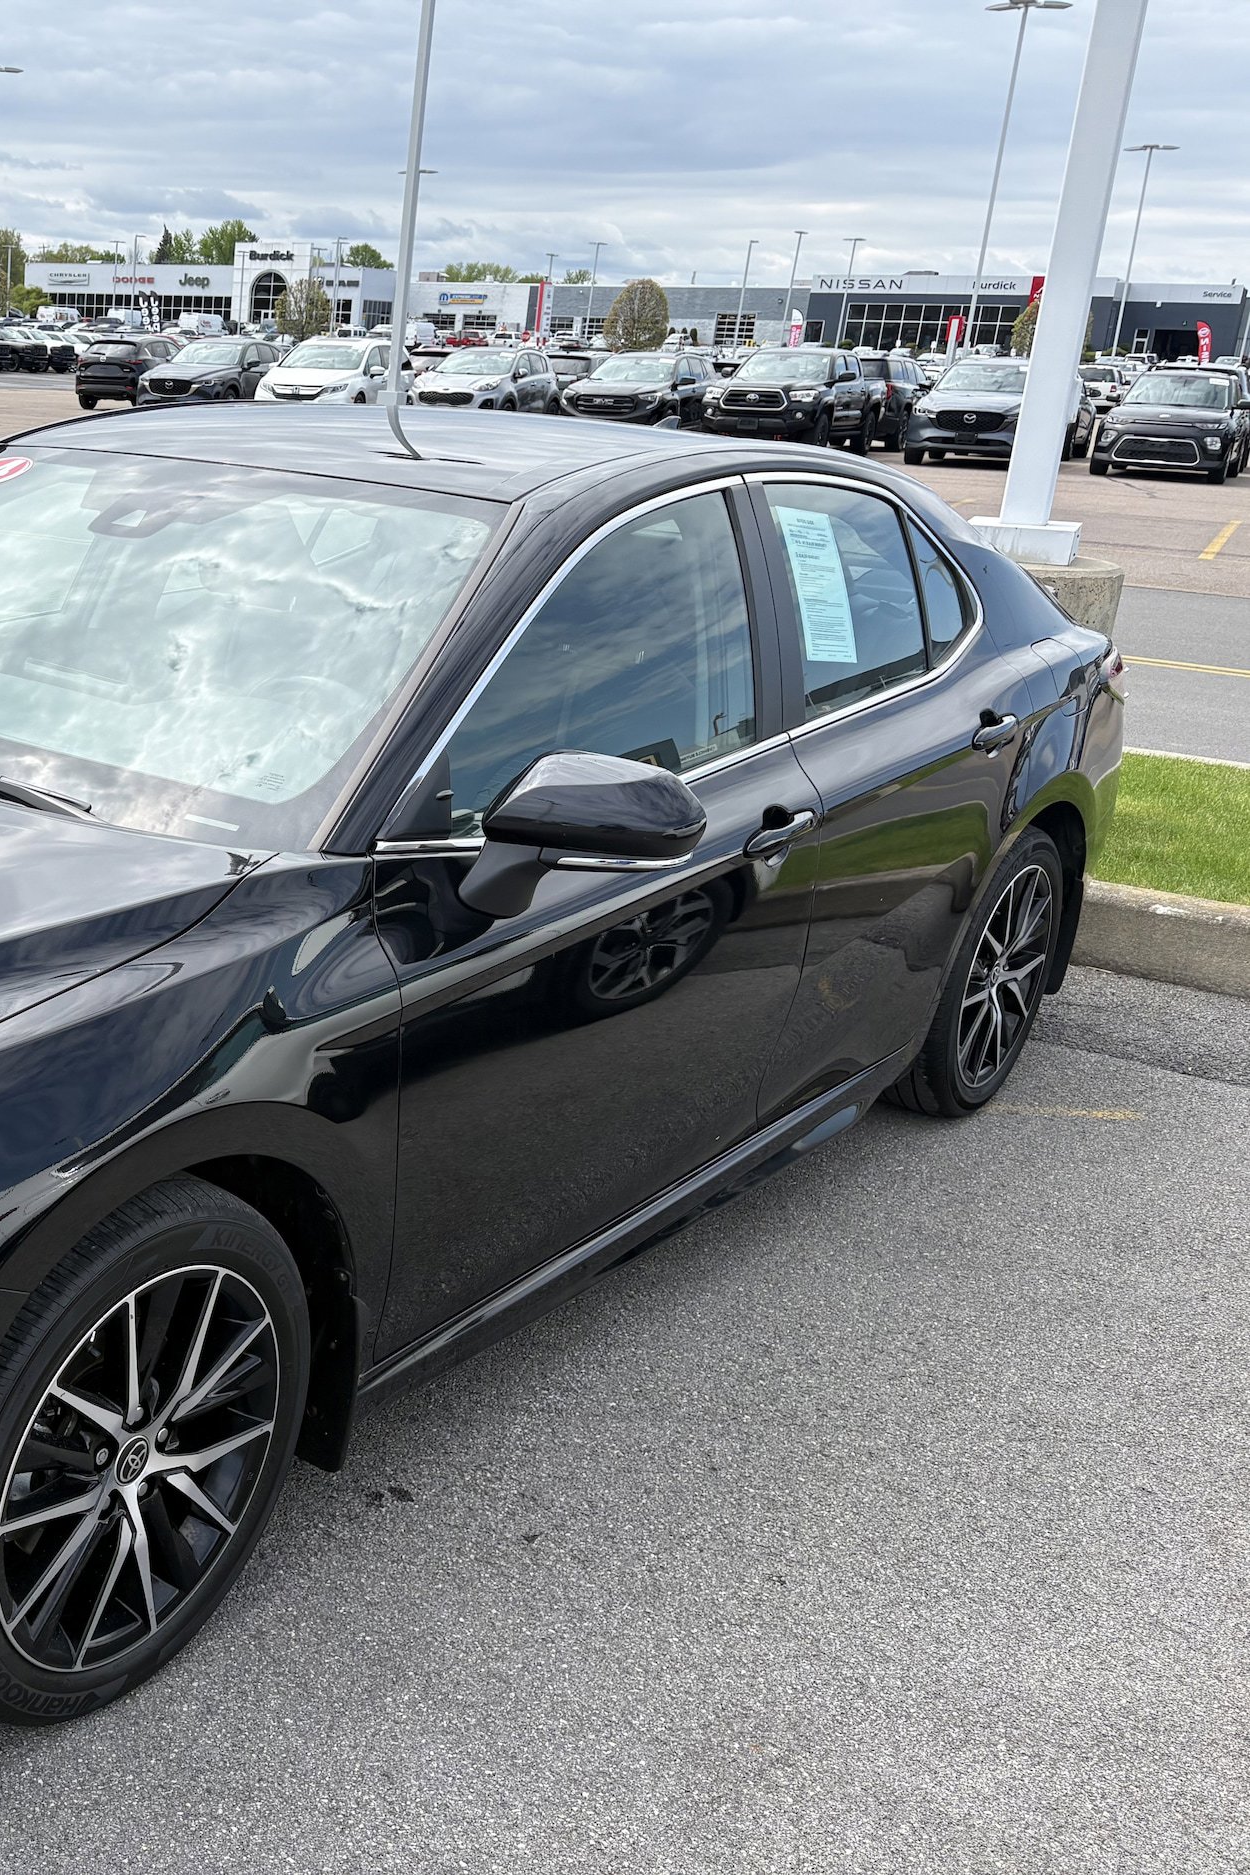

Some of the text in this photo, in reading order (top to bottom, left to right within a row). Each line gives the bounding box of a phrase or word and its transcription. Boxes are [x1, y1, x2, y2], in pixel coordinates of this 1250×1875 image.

[249, 250, 295, 261] Burdick
[112, 276, 155, 285] DODGE
[179, 273, 211, 289] Jeep
[819, 278, 903, 290] NISSAN
[972, 280, 1017, 291] urdick
[1202, 290, 1232, 298] Service
